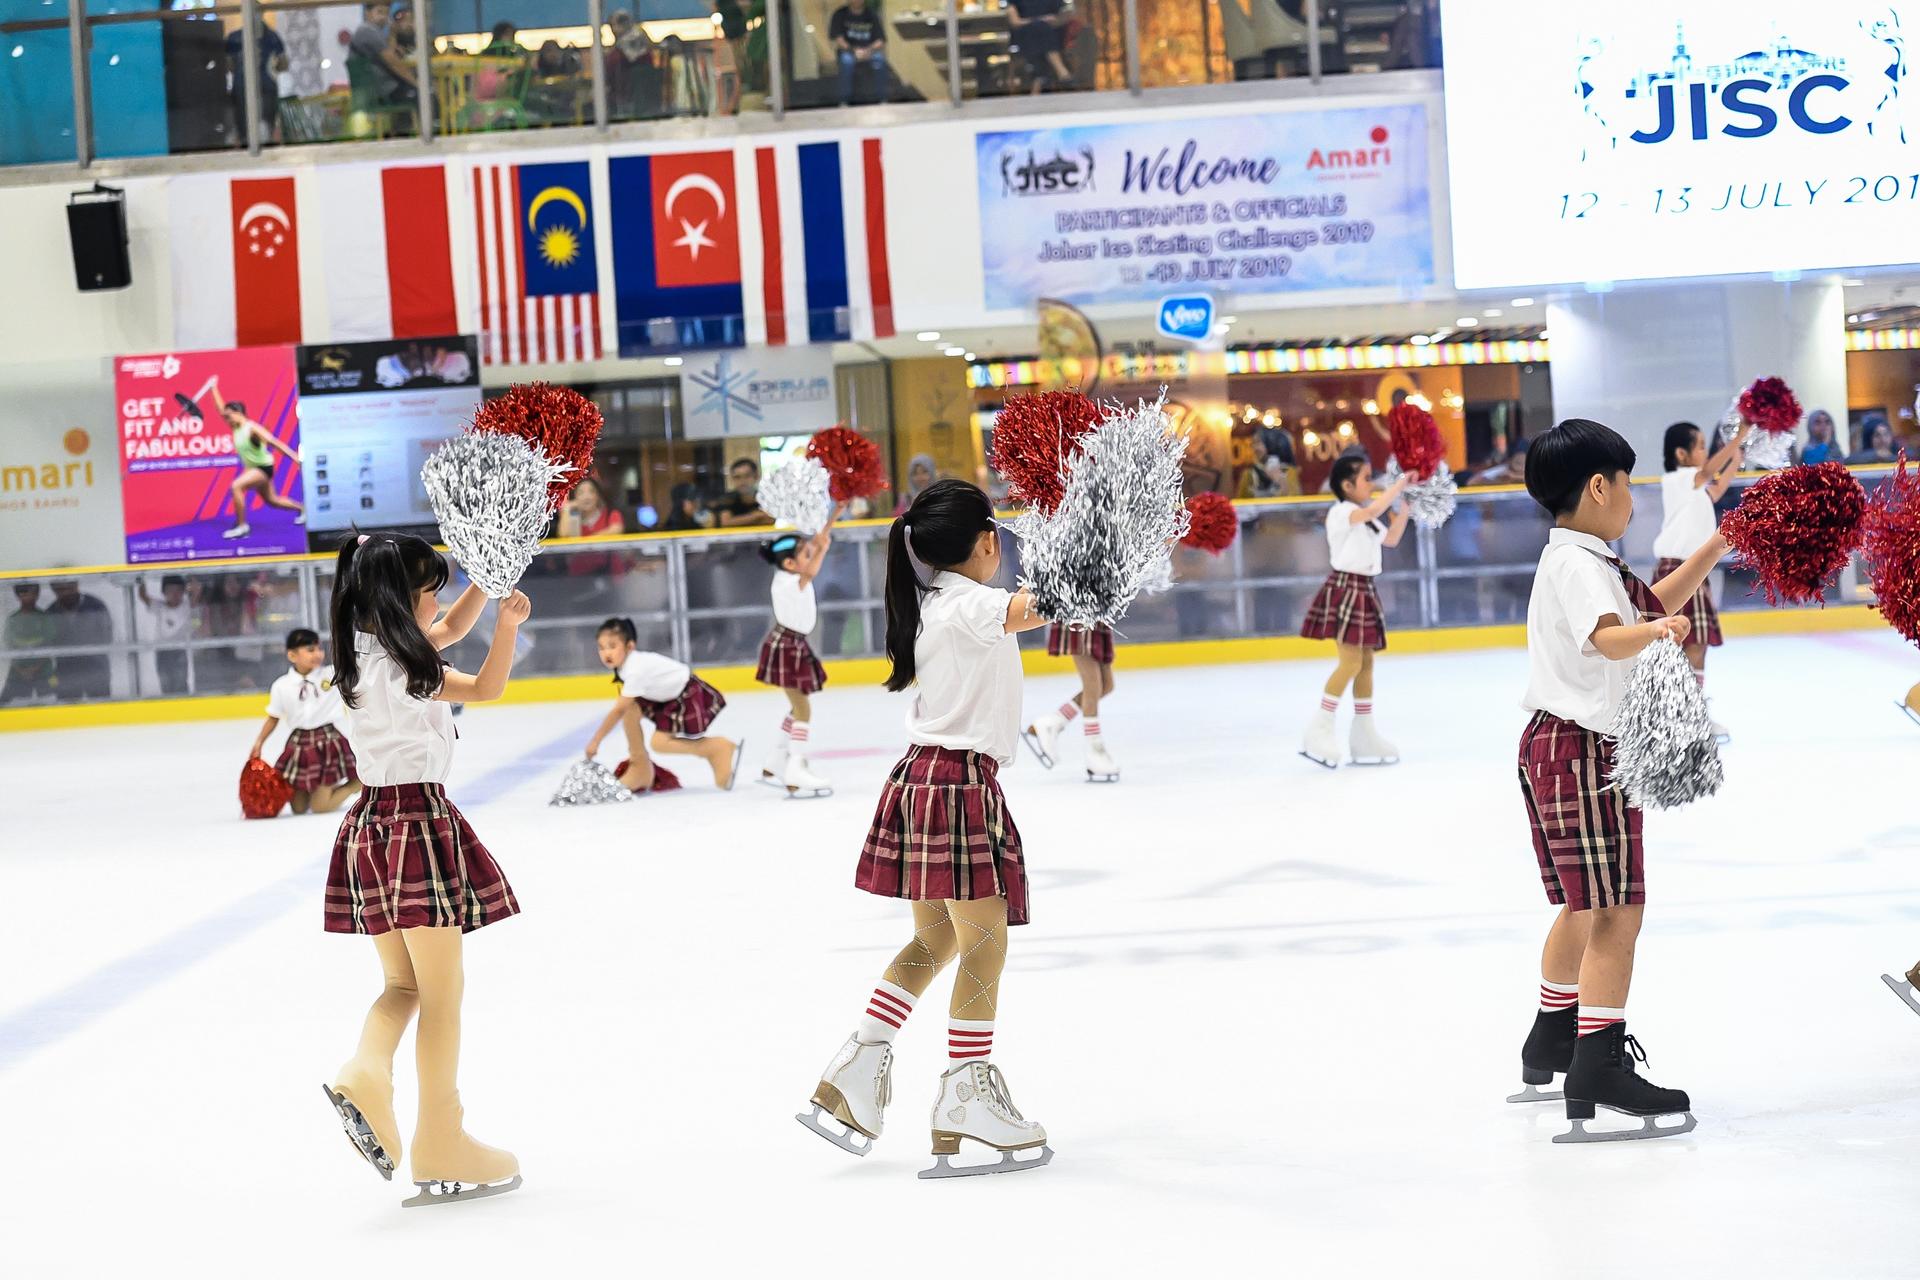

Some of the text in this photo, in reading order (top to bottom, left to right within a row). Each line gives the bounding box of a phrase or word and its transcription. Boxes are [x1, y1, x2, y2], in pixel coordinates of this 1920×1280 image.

[1629, 74, 1853, 144] JISC
[1121, 138, 1282, 196] Welcome
[1306, 126, 1391, 169] Amari
[1055, 192, 1348, 233] PARTICIPANTS & OFFICIALS
[1561, 192, 1599, 219] 12
[1655, 186, 1693, 213] 13
[1711, 178, 1828, 211] JULY
[1037, 238, 1098, 263] Johor
[1135, 233, 1213, 258] Skating
[1216, 225, 1320, 252] Challenge
[1320, 218, 1375, 245] 2019
[1184, 258, 1237, 282] JULY
[1238, 254, 1292, 279] 2019
[122, 397, 165, 418] GET
[124, 416, 204, 438] FIT AND
[125, 434, 234, 459] FABULOUS
